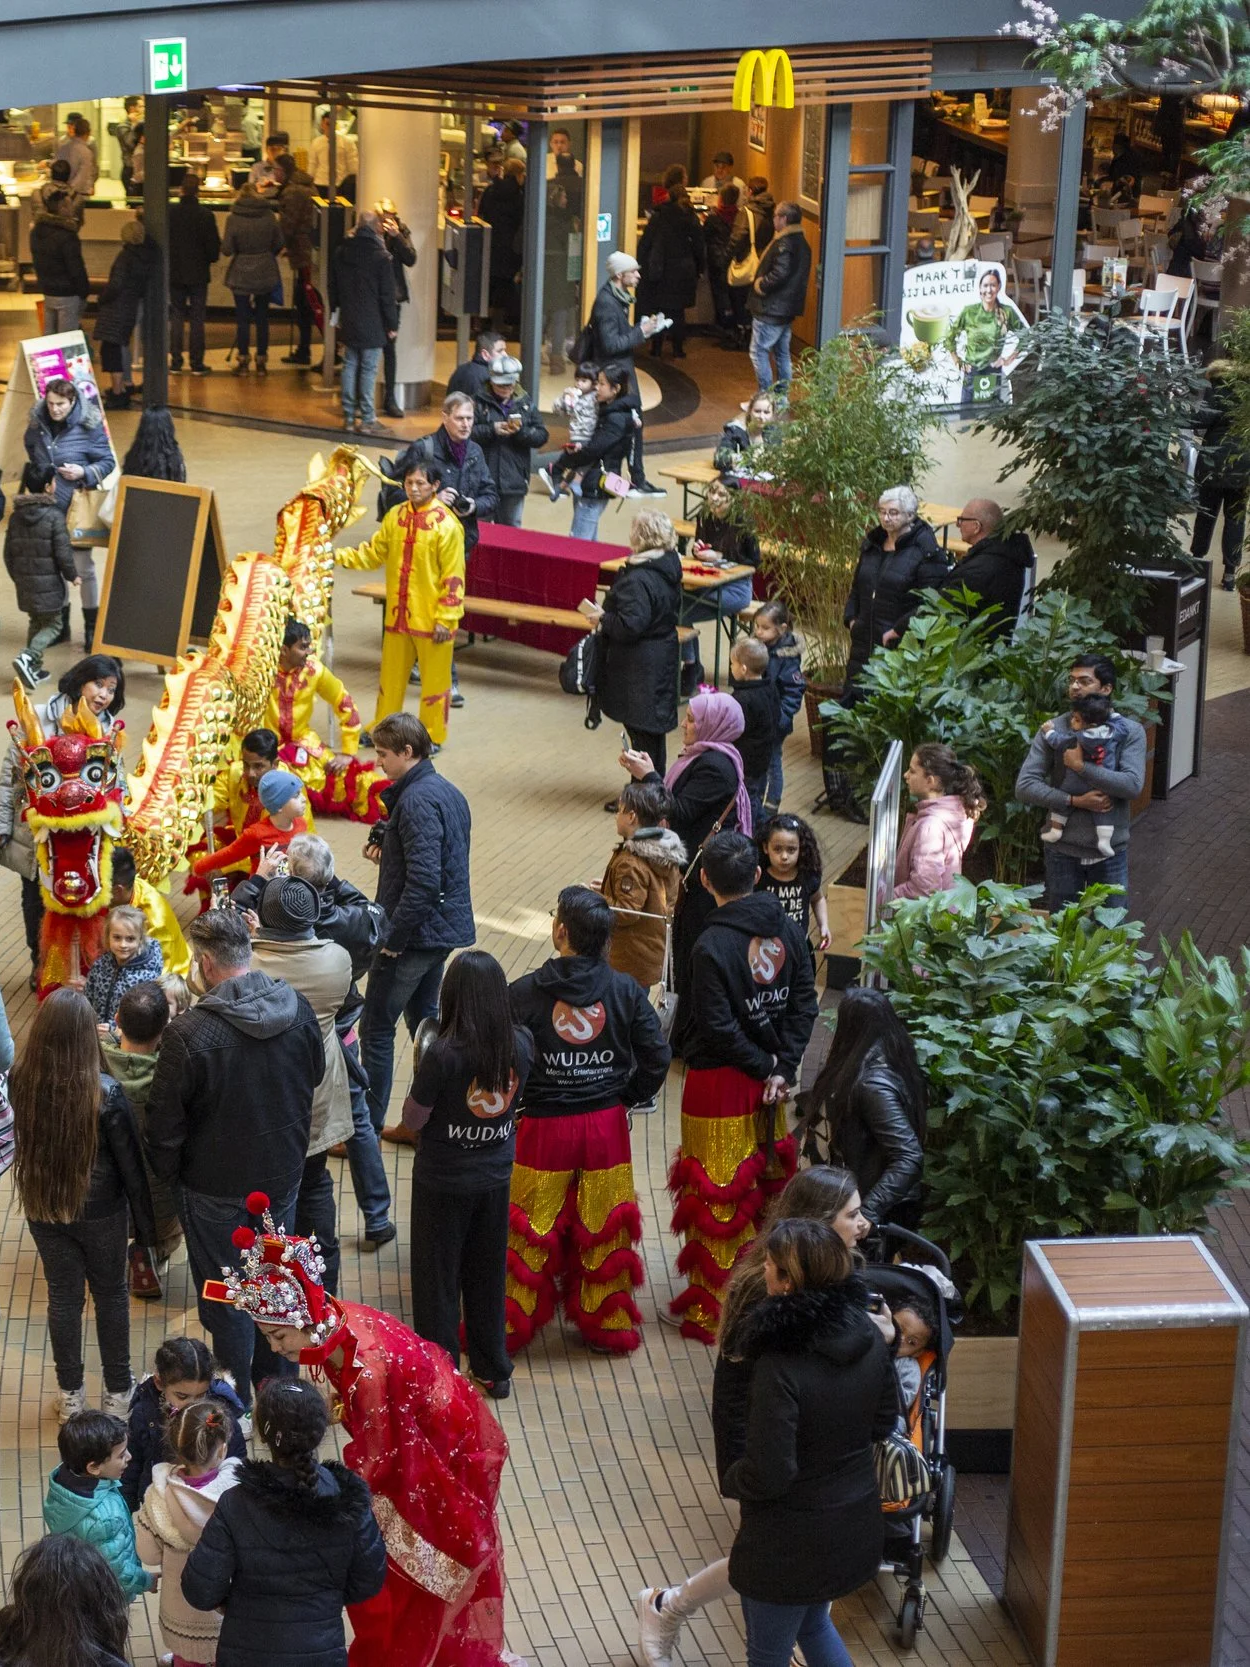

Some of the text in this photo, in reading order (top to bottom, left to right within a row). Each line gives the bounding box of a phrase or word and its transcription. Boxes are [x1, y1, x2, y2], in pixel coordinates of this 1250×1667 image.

[916, 270, 947, 281] MAAK
[922, 286, 936, 296] LA
[939, 280, 974, 294] PLACE!
[1177, 600, 1201, 625] EDANKT
[778, 886, 802, 899] MAY
[789, 898, 803, 911] BE
[745, 986, 790, 1012] WDAO
[542, 1049, 615, 1067] WUDAO
[546, 1068, 566, 1076] Media
[573, 1066, 613, 1077] Entertainment
[448, 1120, 512, 1141] WUDAO
